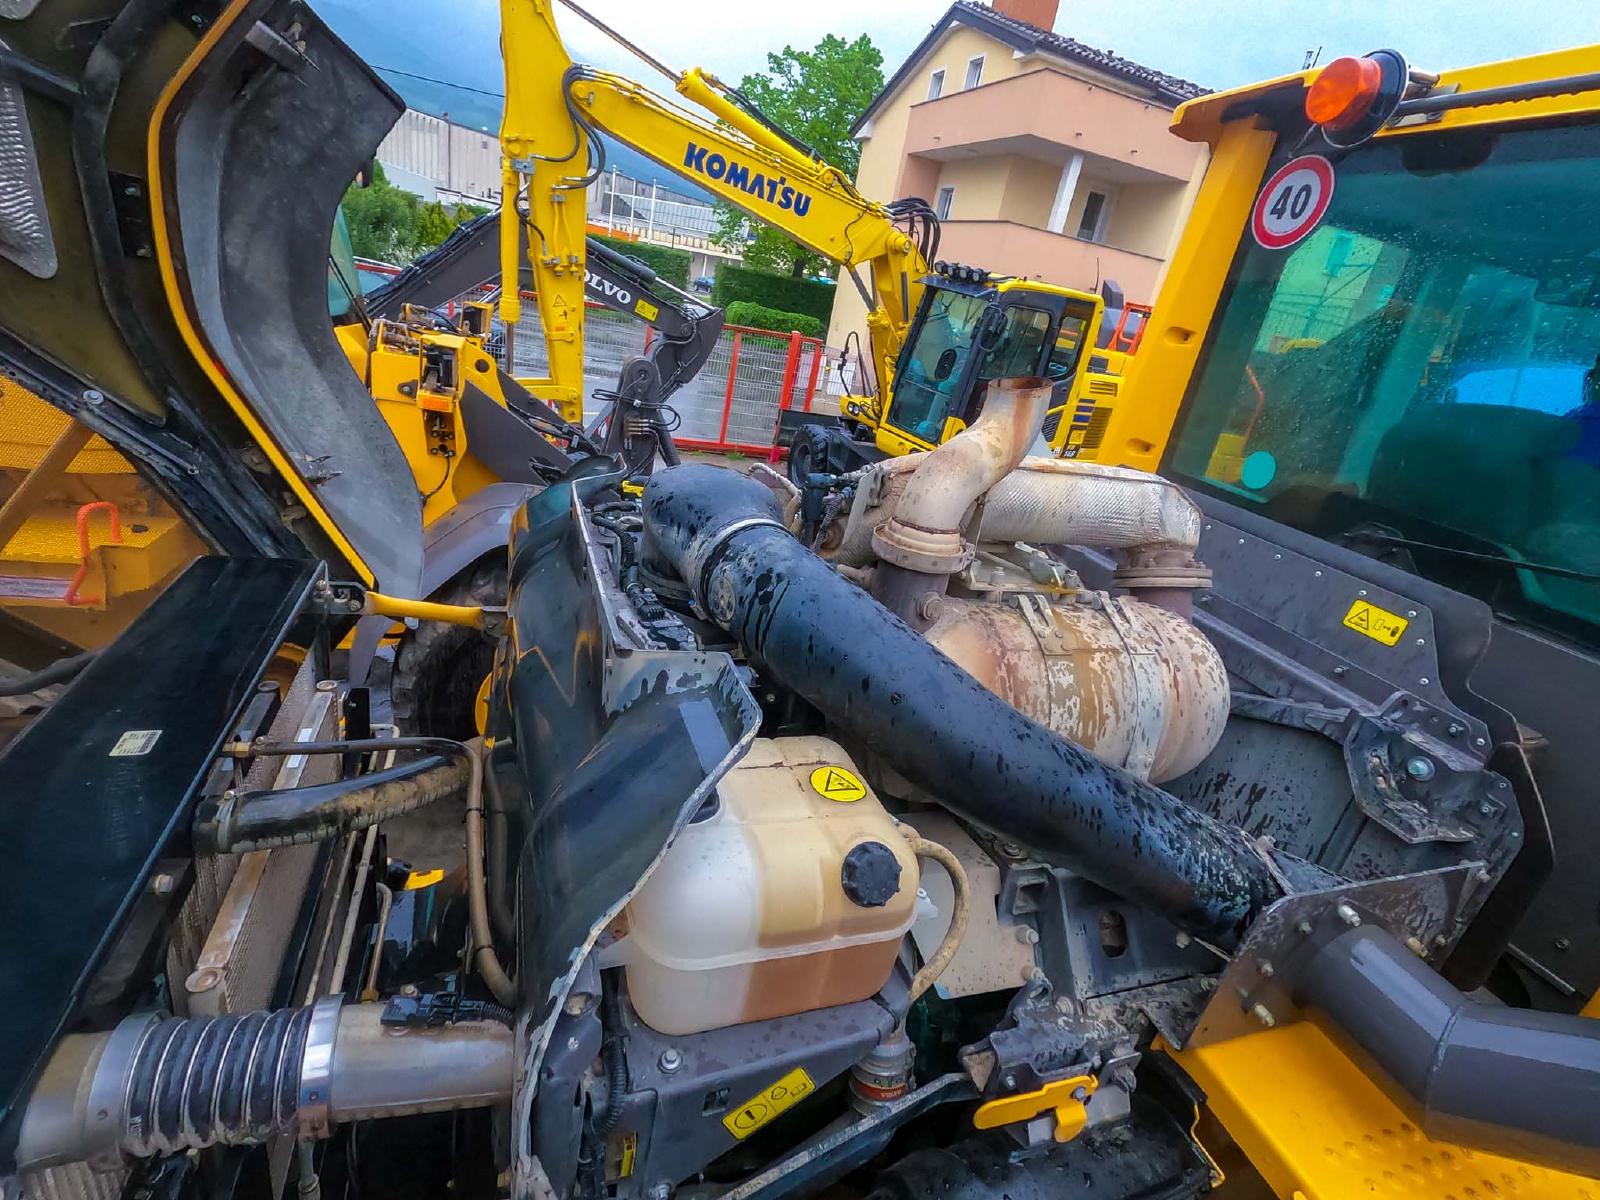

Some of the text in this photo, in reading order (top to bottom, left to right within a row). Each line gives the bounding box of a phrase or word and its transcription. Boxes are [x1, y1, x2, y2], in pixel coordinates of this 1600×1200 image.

[683, 141, 812, 217] KOMATSU
[1270, 184, 1312, 220] 40
[584, 269, 631, 304] LVO
